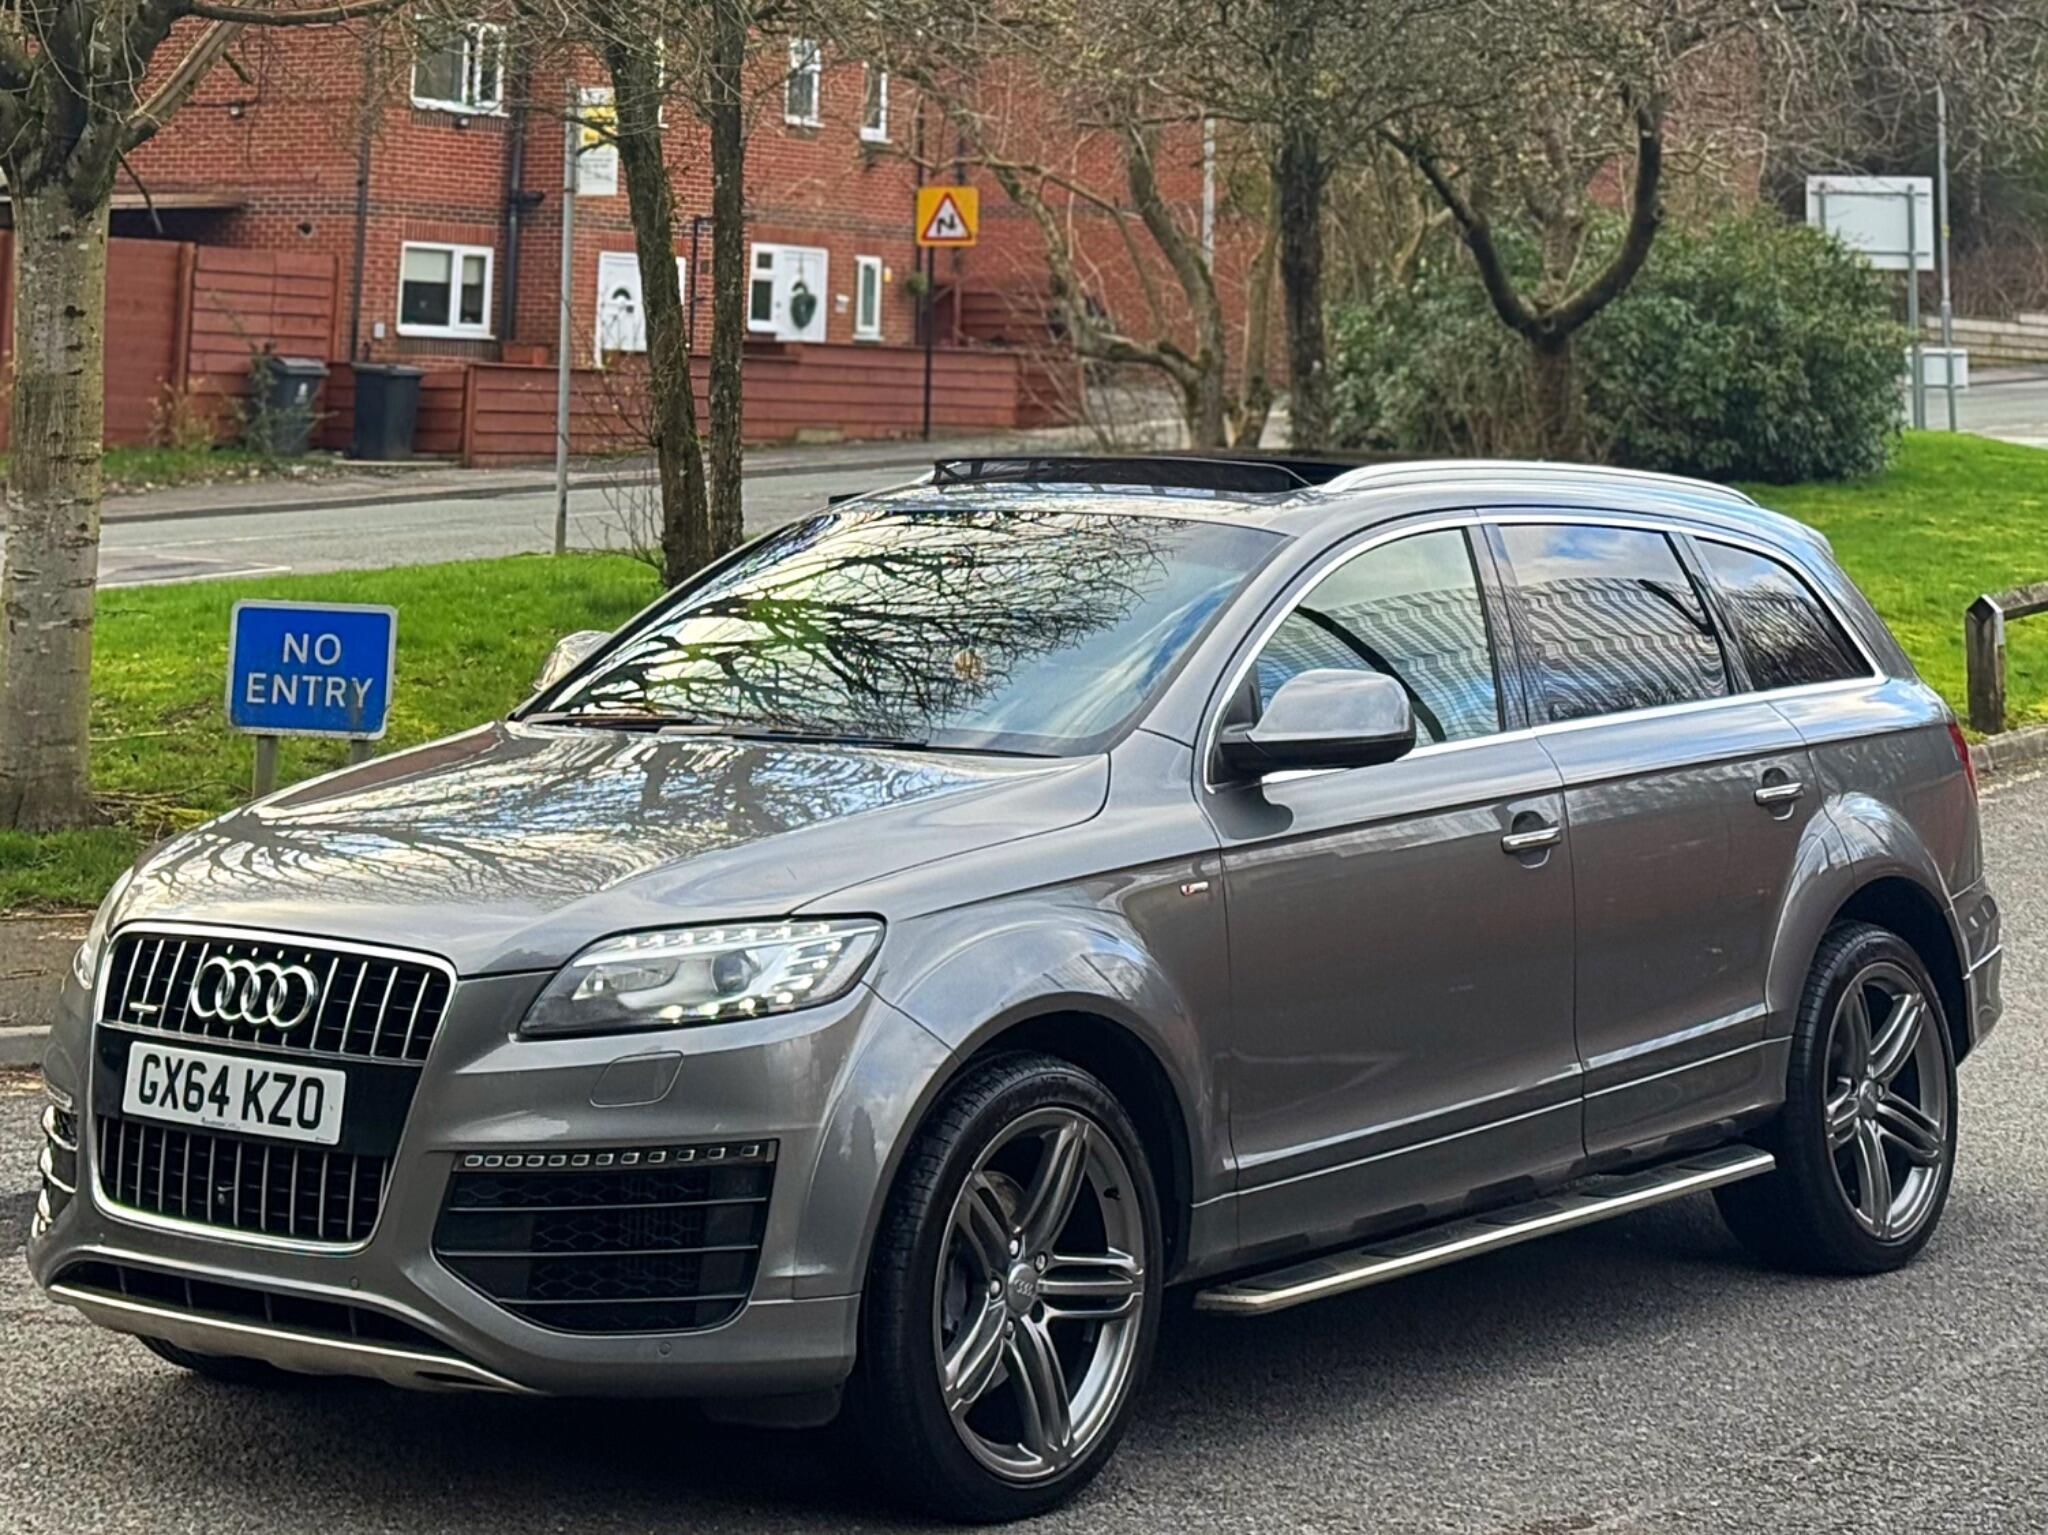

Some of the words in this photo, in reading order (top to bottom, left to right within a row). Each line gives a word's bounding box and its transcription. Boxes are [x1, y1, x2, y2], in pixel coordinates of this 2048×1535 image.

[282, 632, 342, 666] NO
[246, 672, 374, 708] ENTRY
[138, 1053, 230, 1117] GX64
[241, 1068, 325, 1130] KZO
